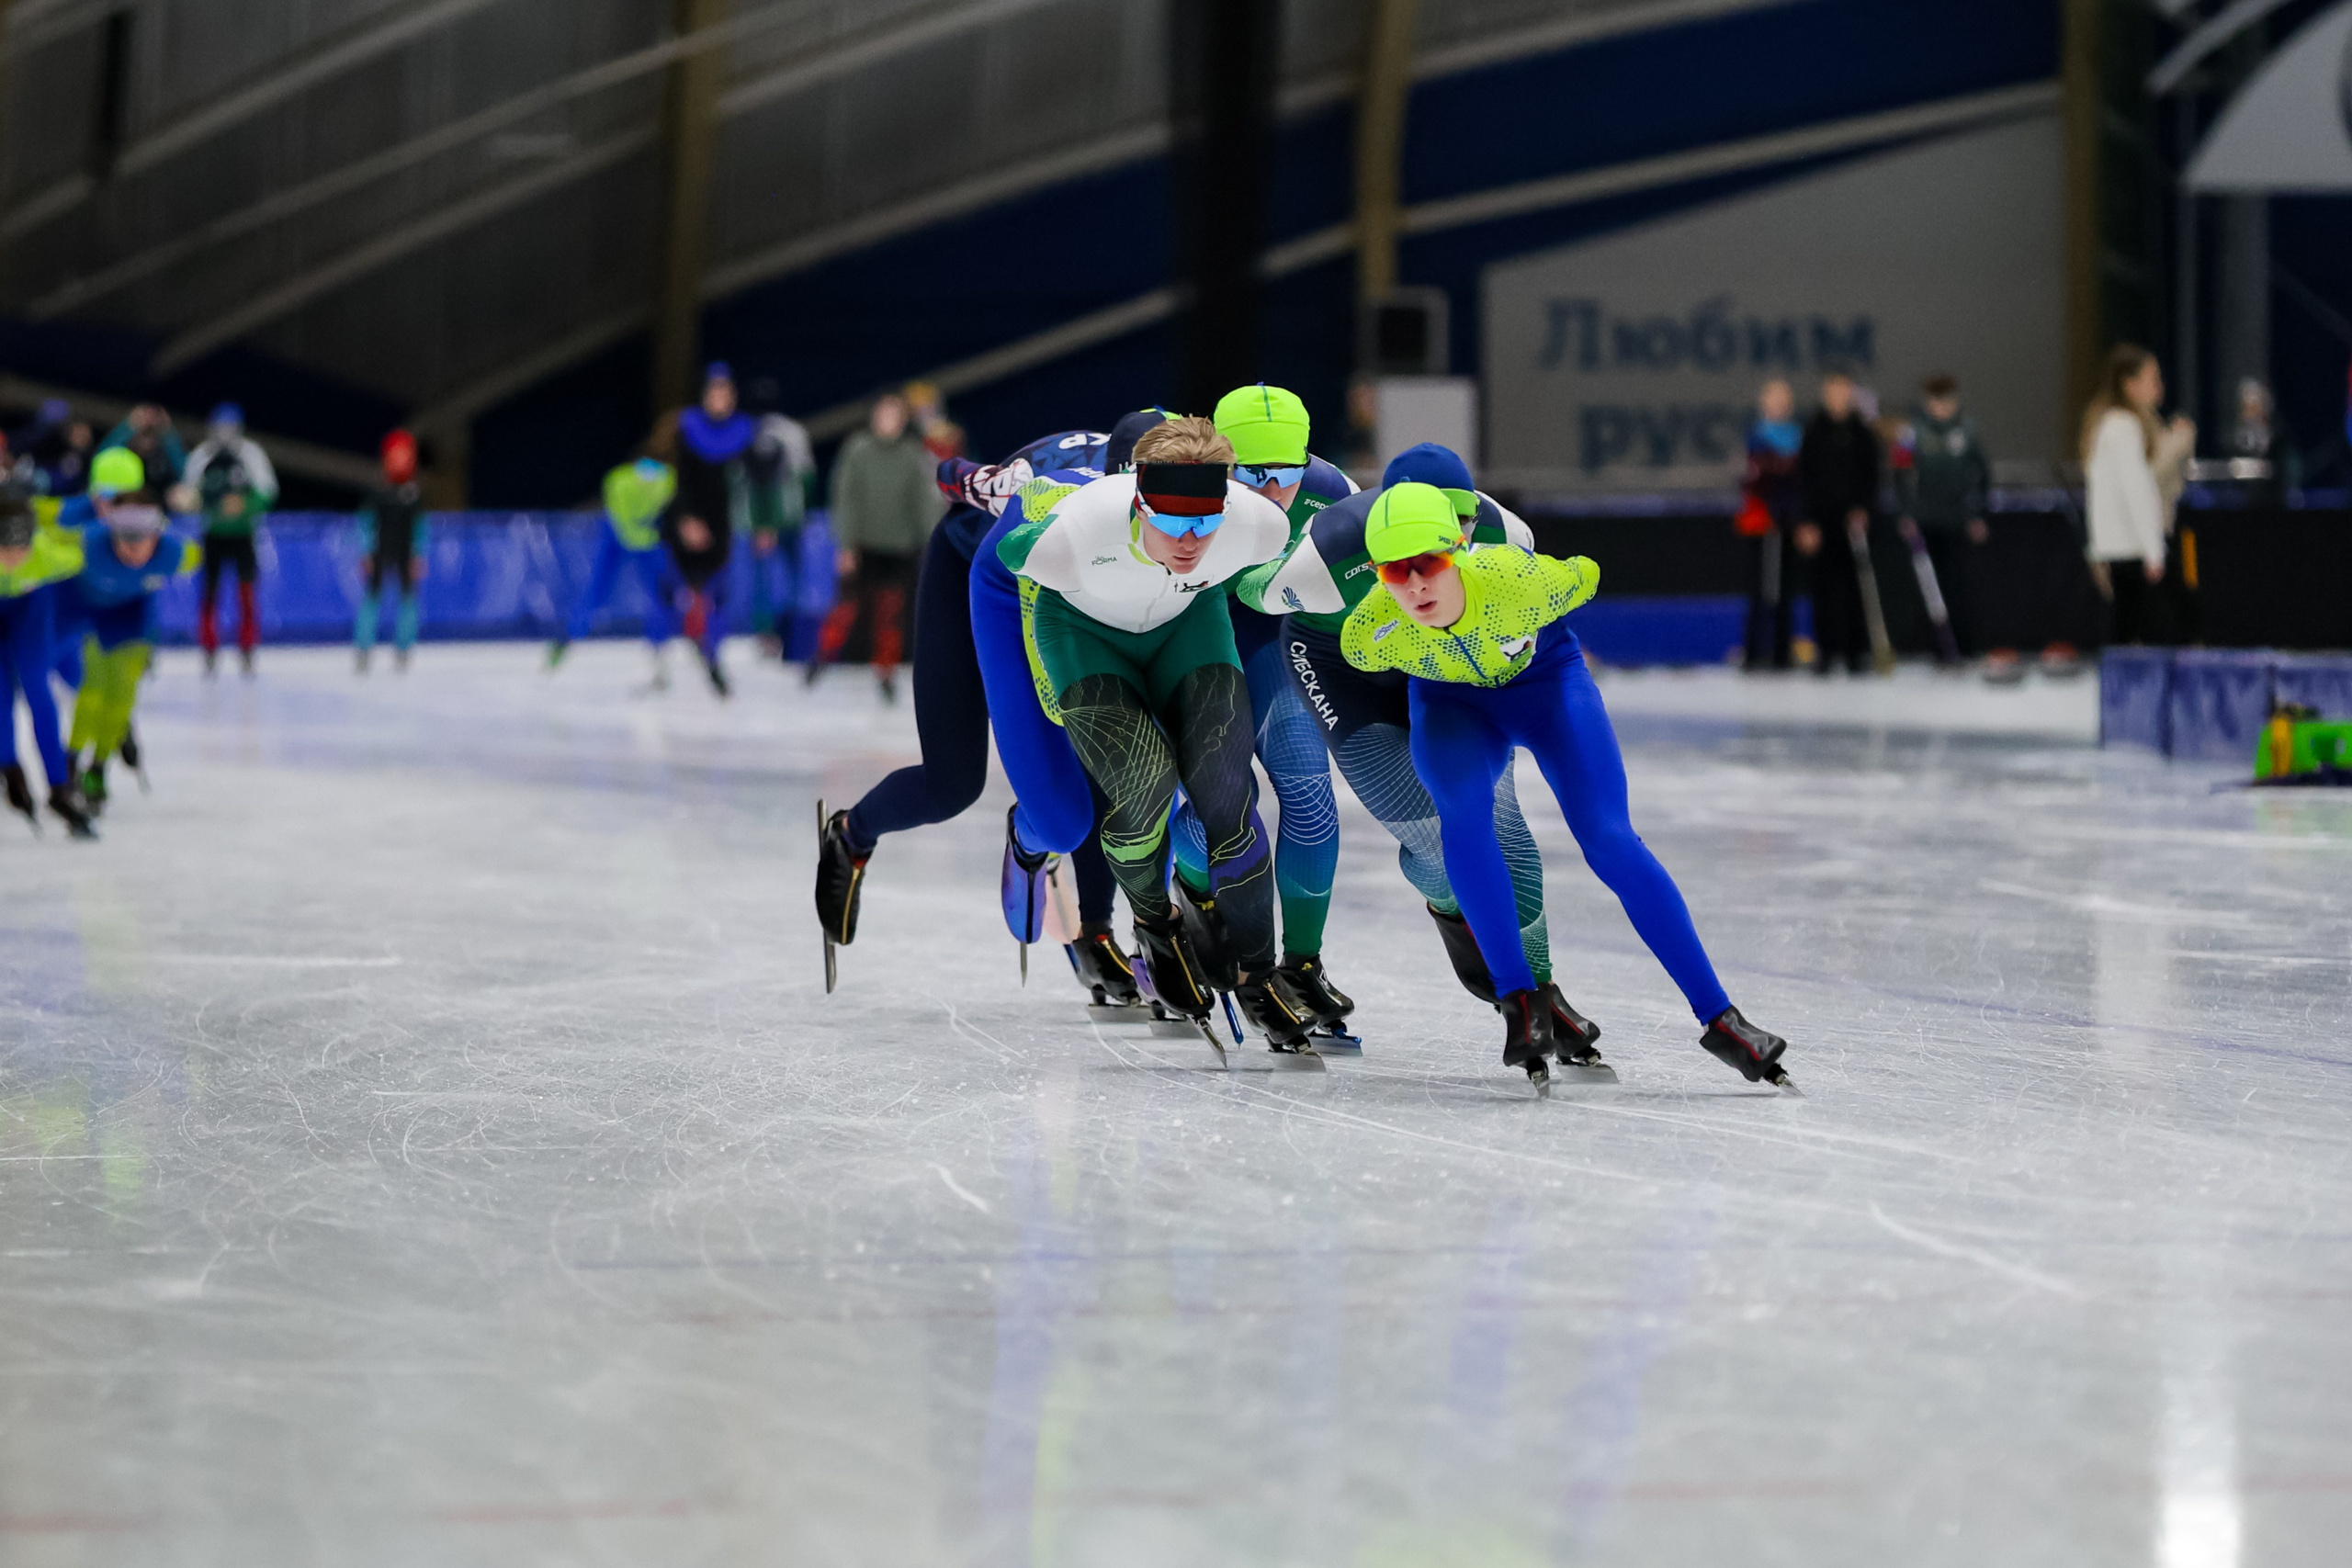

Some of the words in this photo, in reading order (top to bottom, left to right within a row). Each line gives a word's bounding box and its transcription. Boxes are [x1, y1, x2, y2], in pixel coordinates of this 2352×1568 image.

[1540, 293, 1876, 371] Любим
[1579, 402, 1744, 477] рус
[1290, 641, 1339, 731] СИБСКАНА
